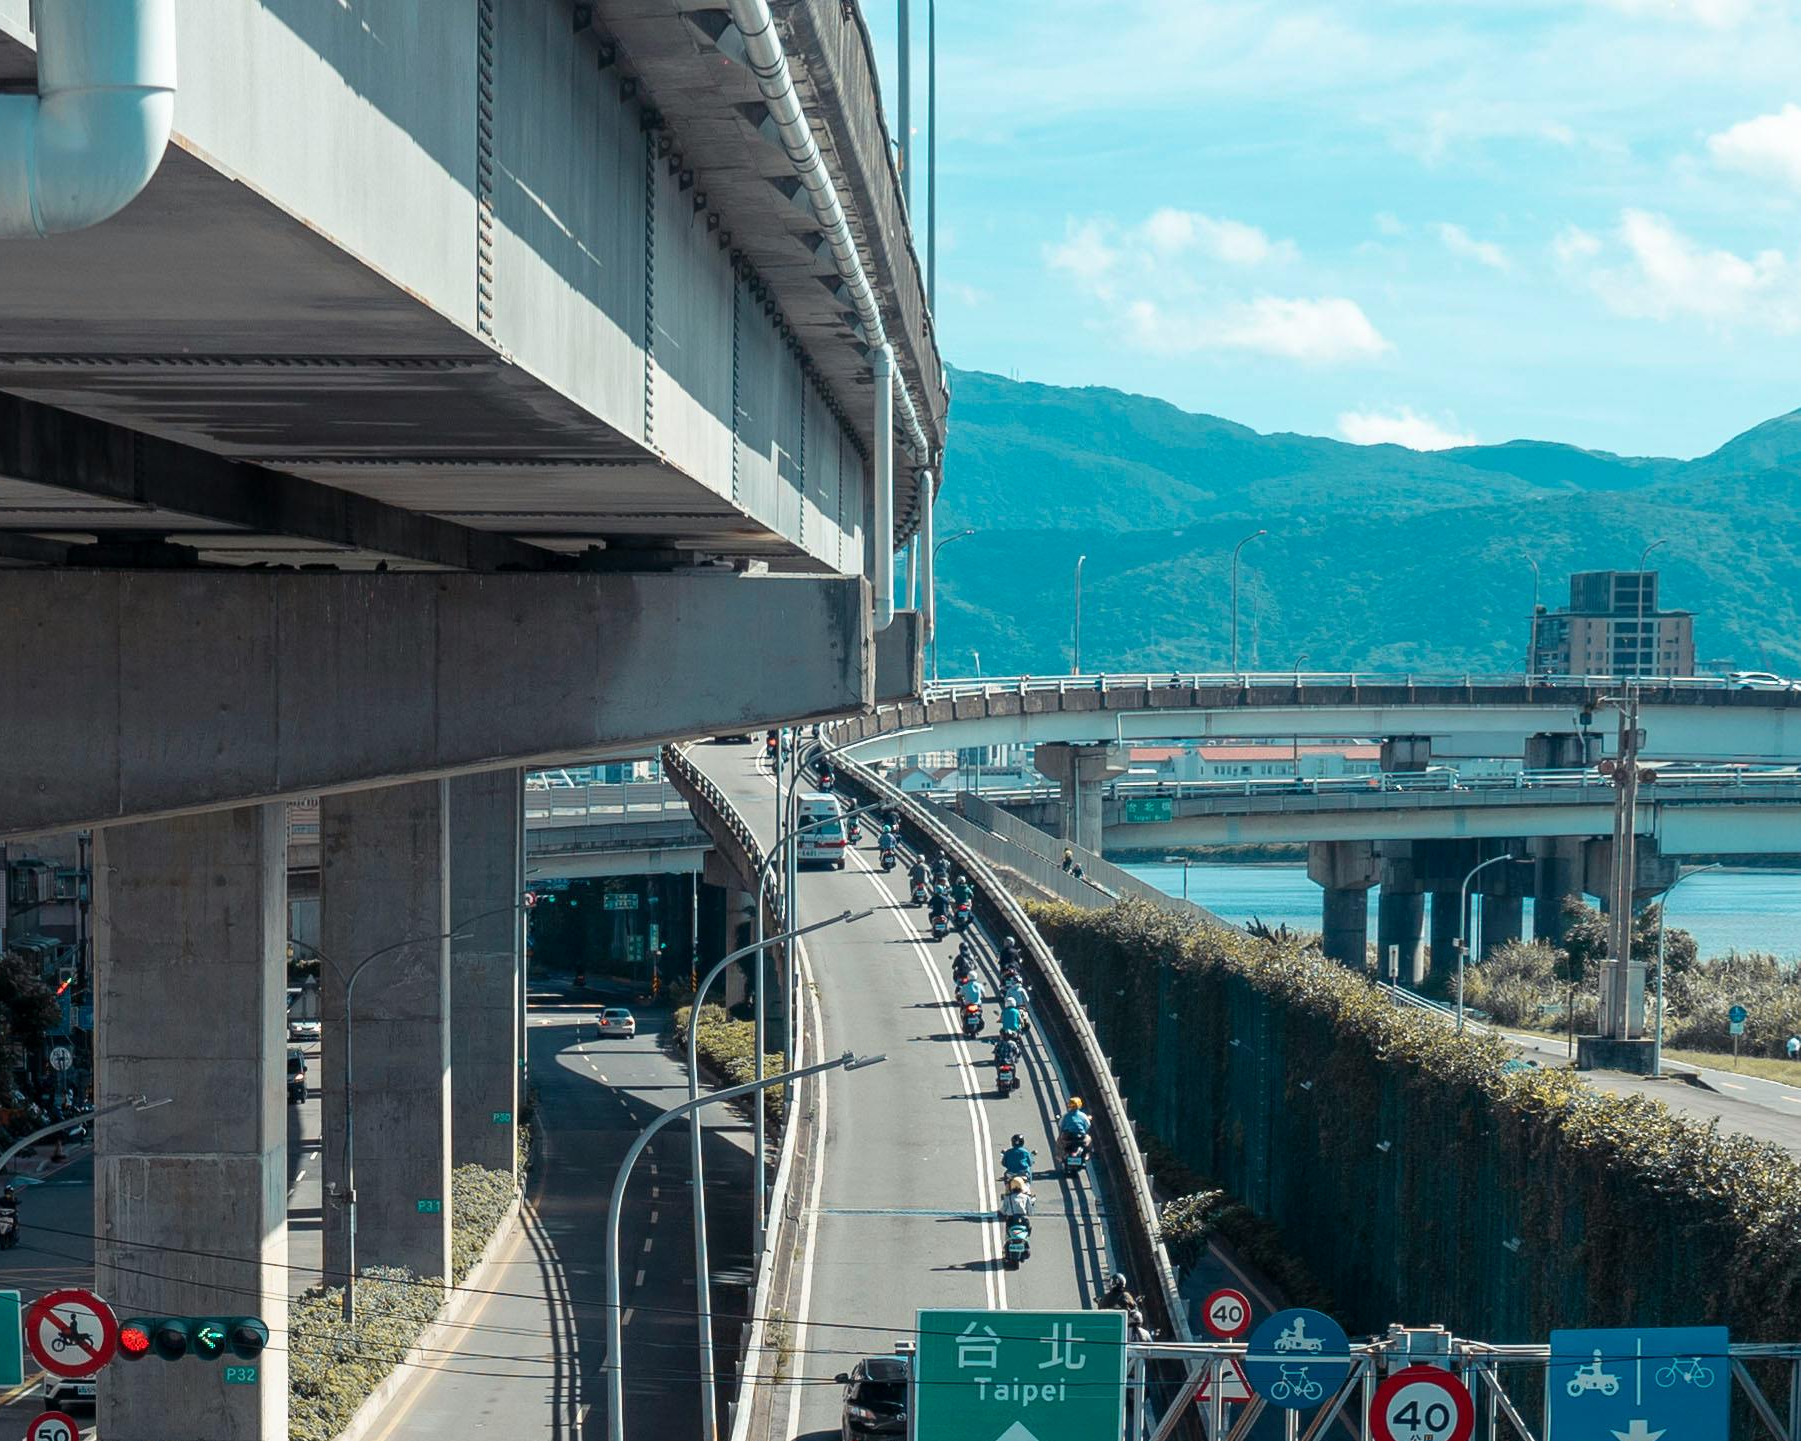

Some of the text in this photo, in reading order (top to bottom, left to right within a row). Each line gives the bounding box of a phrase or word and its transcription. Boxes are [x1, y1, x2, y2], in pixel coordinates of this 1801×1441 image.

[419, 1200, 440, 1212] P31
[1212, 1305, 1242, 1323] 40
[955, 1321, 1086, 1370] 台北
[227, 1368, 254, 1381] P32
[974, 1377, 1066, 1407] Taipei
[1393, 1401, 1450, 1432] 40
